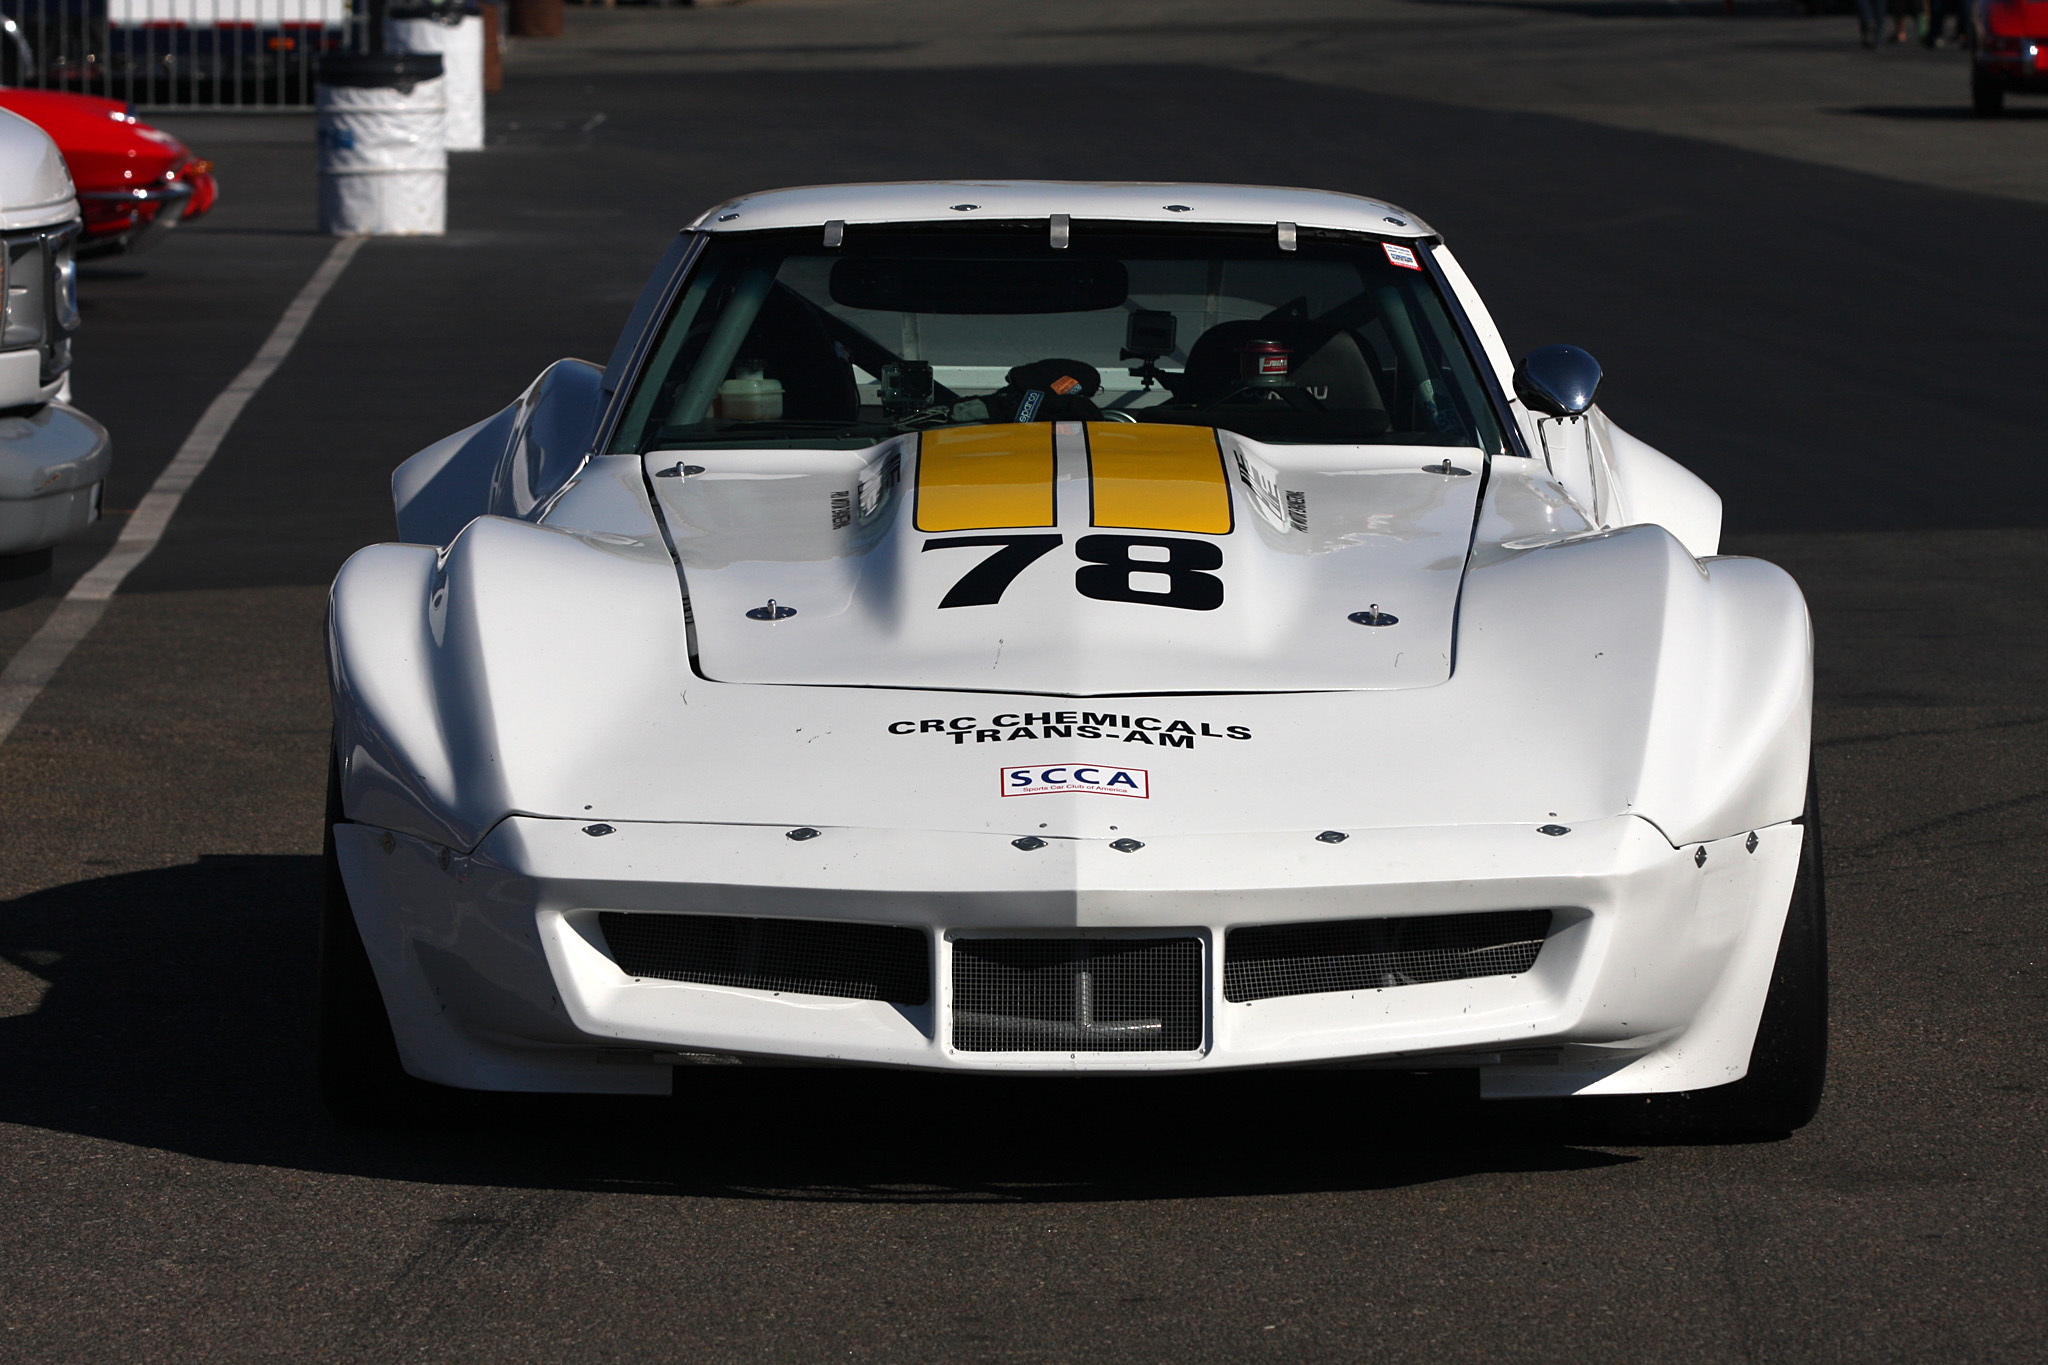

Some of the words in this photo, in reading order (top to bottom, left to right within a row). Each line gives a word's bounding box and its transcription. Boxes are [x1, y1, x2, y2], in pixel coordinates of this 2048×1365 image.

[1019, 392, 1038, 423] sparco
[921, 534, 1224, 612] 78
[888, 716, 978, 735] CRC
[992, 711, 1253, 741] CHEMICALS
[946, 725, 1195, 749] TRANS-AM
[1010, 768, 1139, 789] SCCA
[1096, 785, 1128, 793] America
